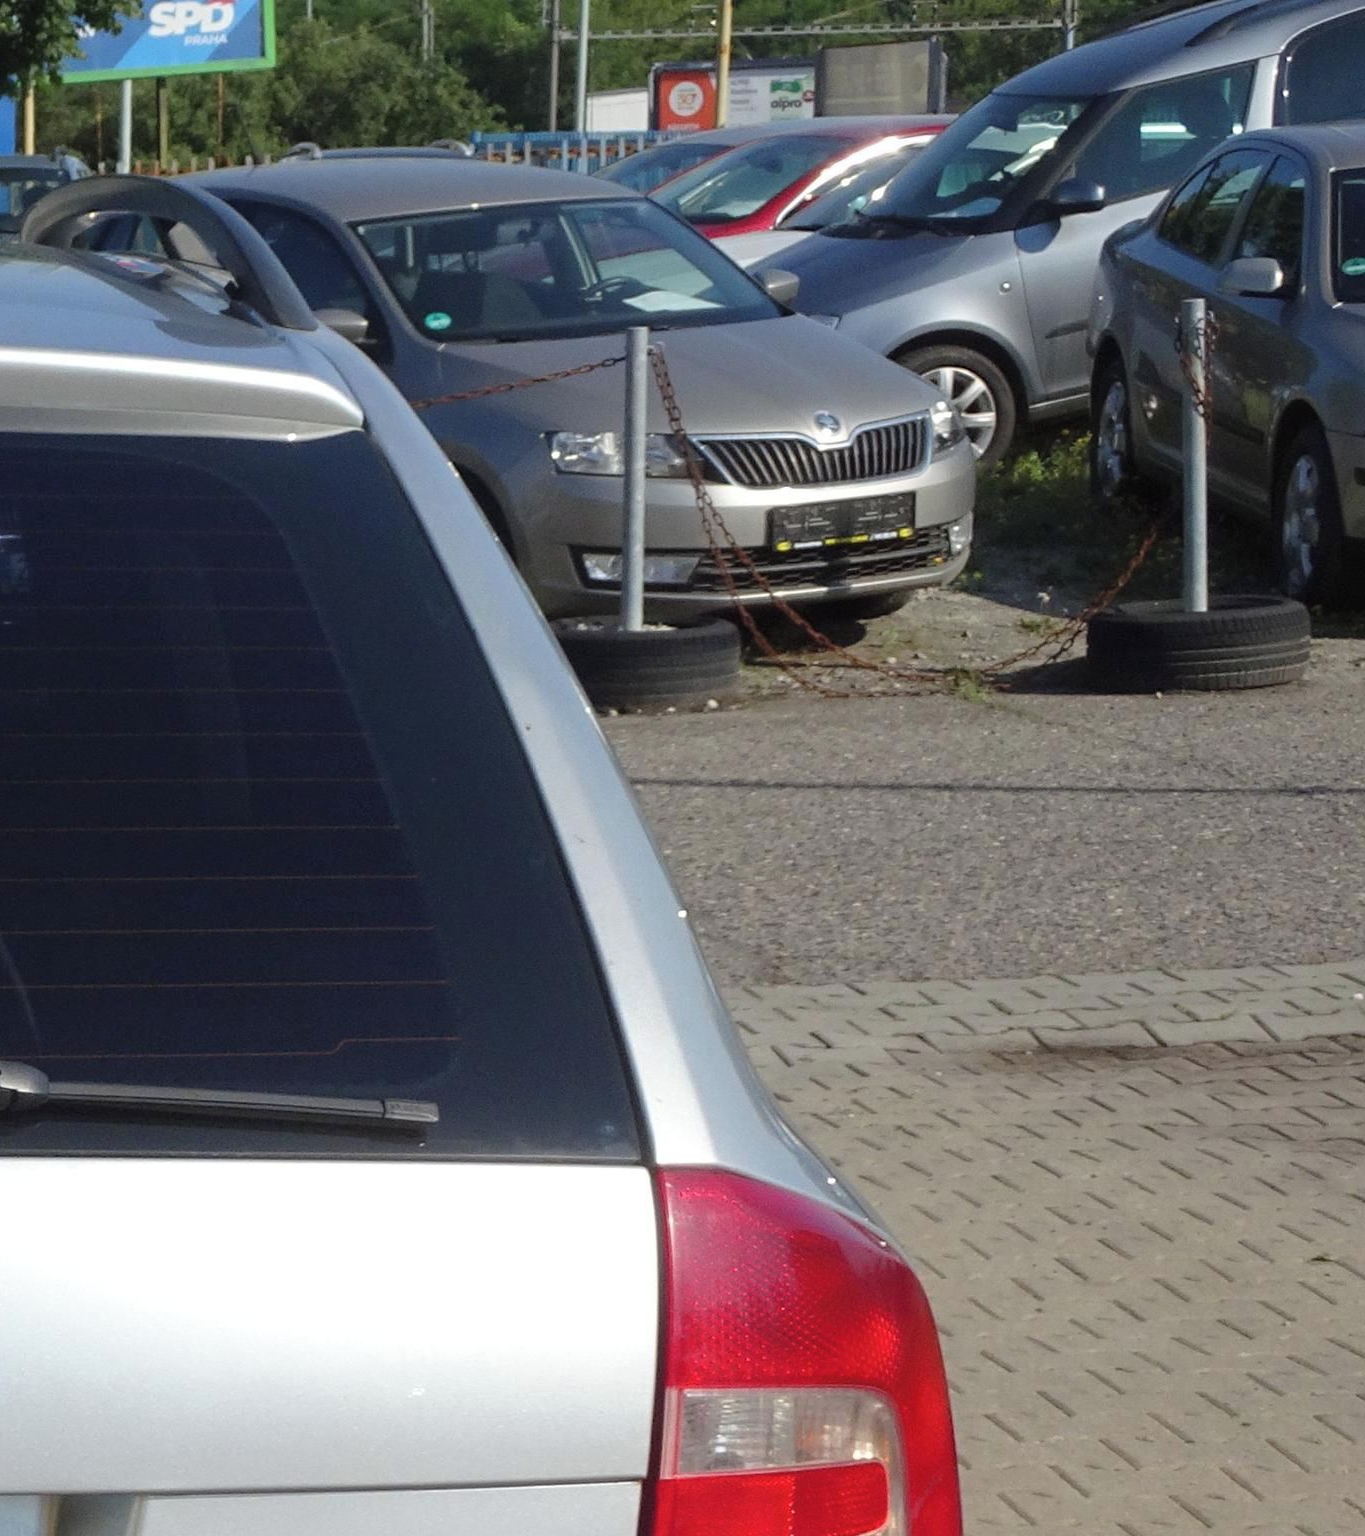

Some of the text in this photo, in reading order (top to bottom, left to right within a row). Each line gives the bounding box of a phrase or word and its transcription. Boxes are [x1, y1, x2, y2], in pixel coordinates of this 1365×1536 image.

[149, 0, 235, 37] SPD
[184, 34, 227, 46] PRAHA
[771, 98, 802, 112] alpro
